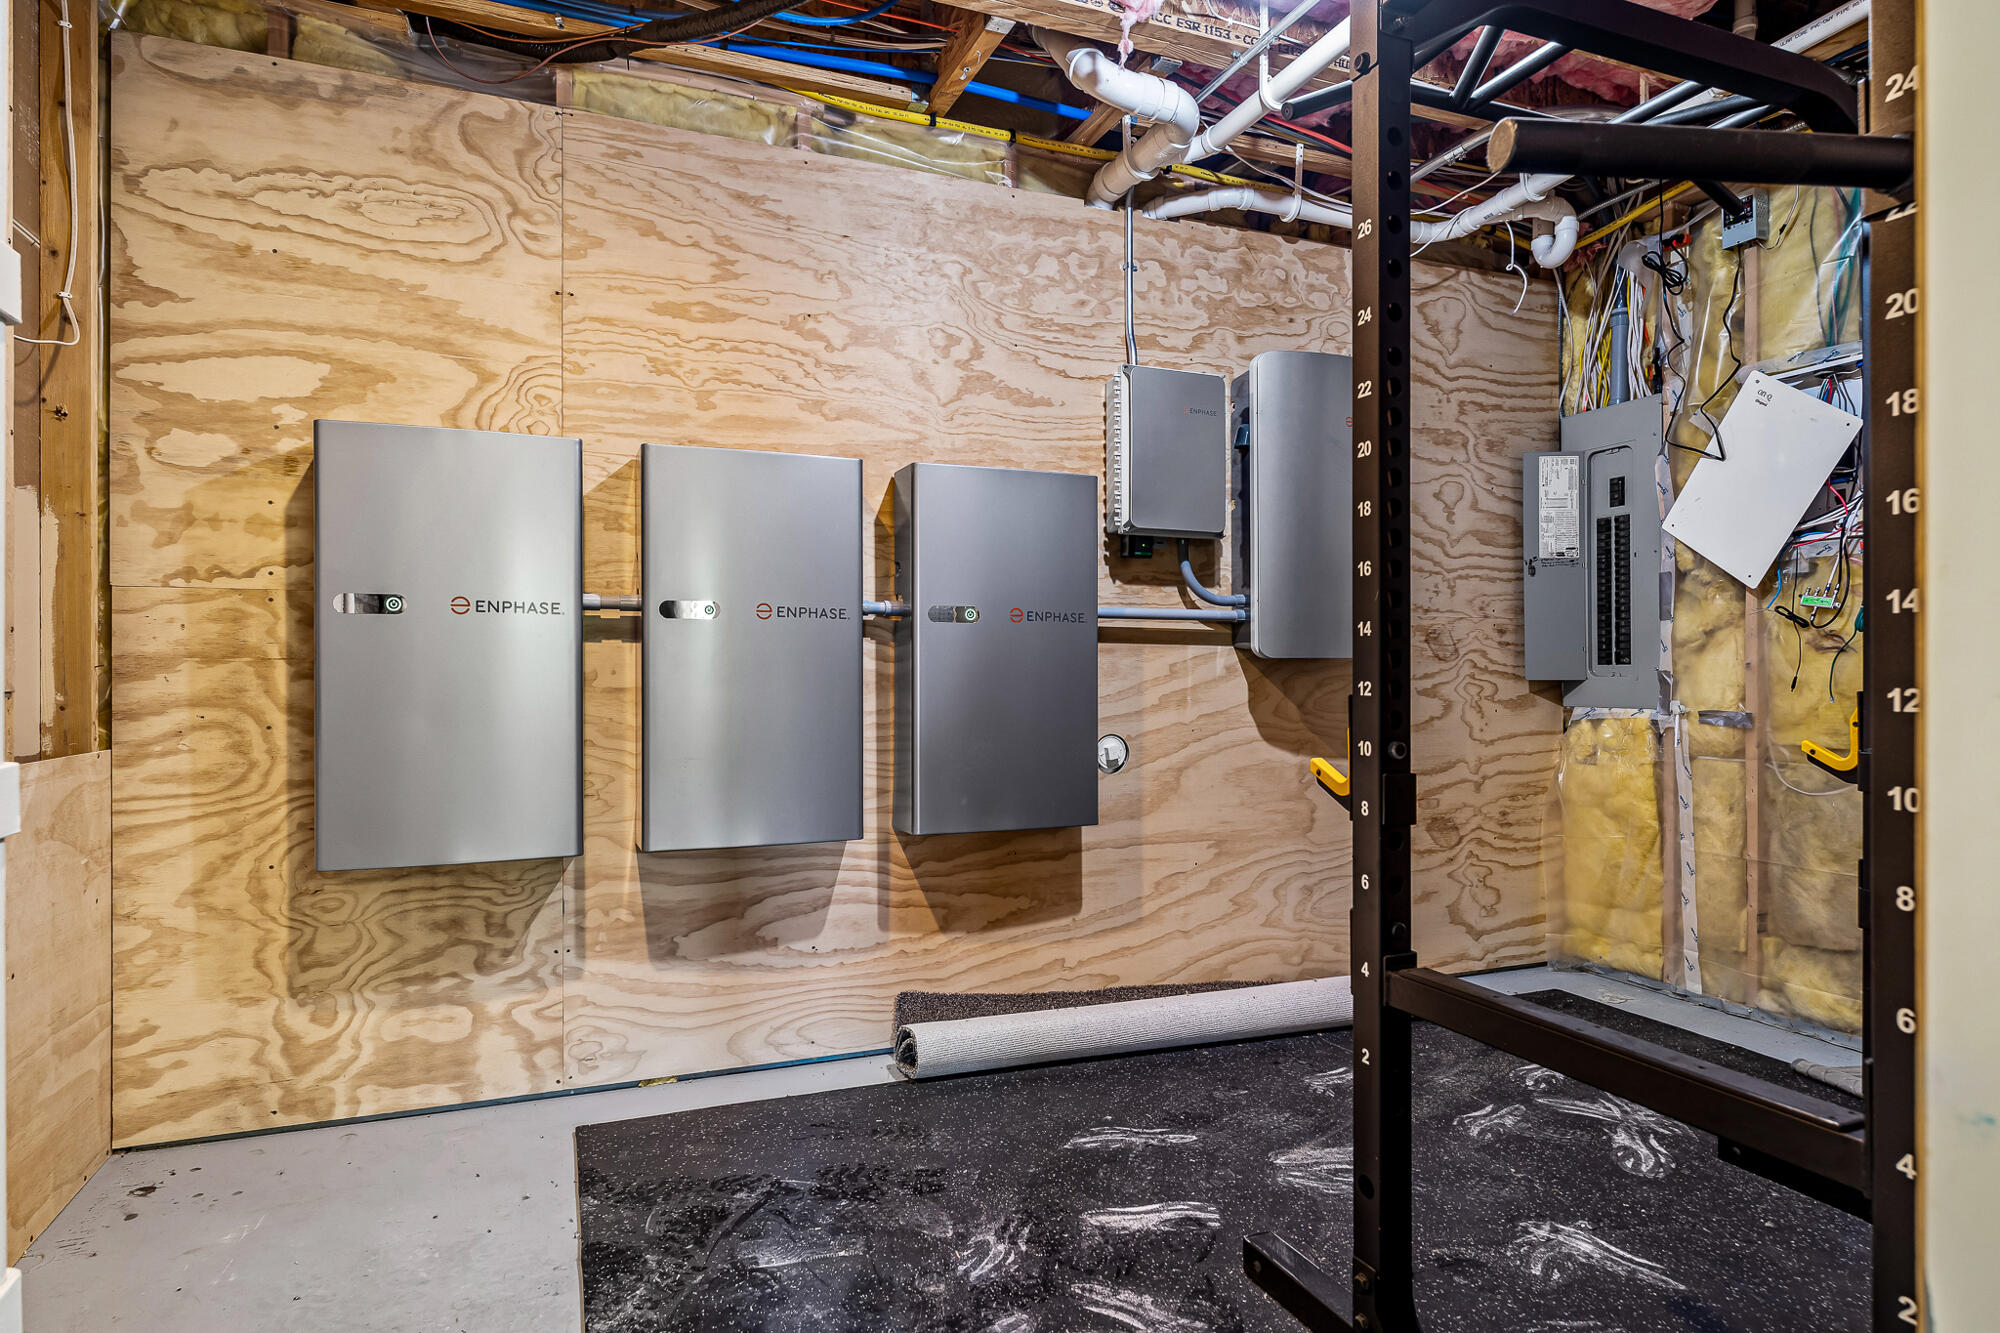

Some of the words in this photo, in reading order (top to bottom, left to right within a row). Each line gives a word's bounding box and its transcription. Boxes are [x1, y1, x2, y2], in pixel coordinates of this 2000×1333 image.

[1176, 17, 1201, 32] ESR
[1204, 24, 1232, 40] 1153
[1884, 64, 1919, 103] 24
[1357, 218, 1372, 240] 26
[1884, 287, 1920, 320] 20
[1357, 306, 1372, 326] 24
[1357, 380, 1372, 399] 22
[1189, 407, 1217, 417] ENPHASE
[1885, 388, 1920, 417] 18
[1357, 440, 1372, 459] 20
[1357, 500, 1372, 518] 18
[1885, 487, 1920, 515] 16
[1357, 560, 1372, 577] 16
[1886, 588, 1920, 614] 14
[1357, 620, 1372, 637] 14
[1357, 680, 1372, 697] 12
[1887, 687, 1920, 713] 12
[1357, 740, 1372, 757] 10
[1361, 800, 1369, 816] 8
[1887, 786, 1920, 813] 10
[1361, 874, 1369, 890] 6
[1895, 885, 1916, 912] 8
[1361, 961, 1370, 978] 4
[1895, 1007, 1917, 1034] 6
[1361, 1048, 1370, 1065] 2
[1895, 1153, 1917, 1180] 4
[1897, 1295, 1918, 1326] 2
